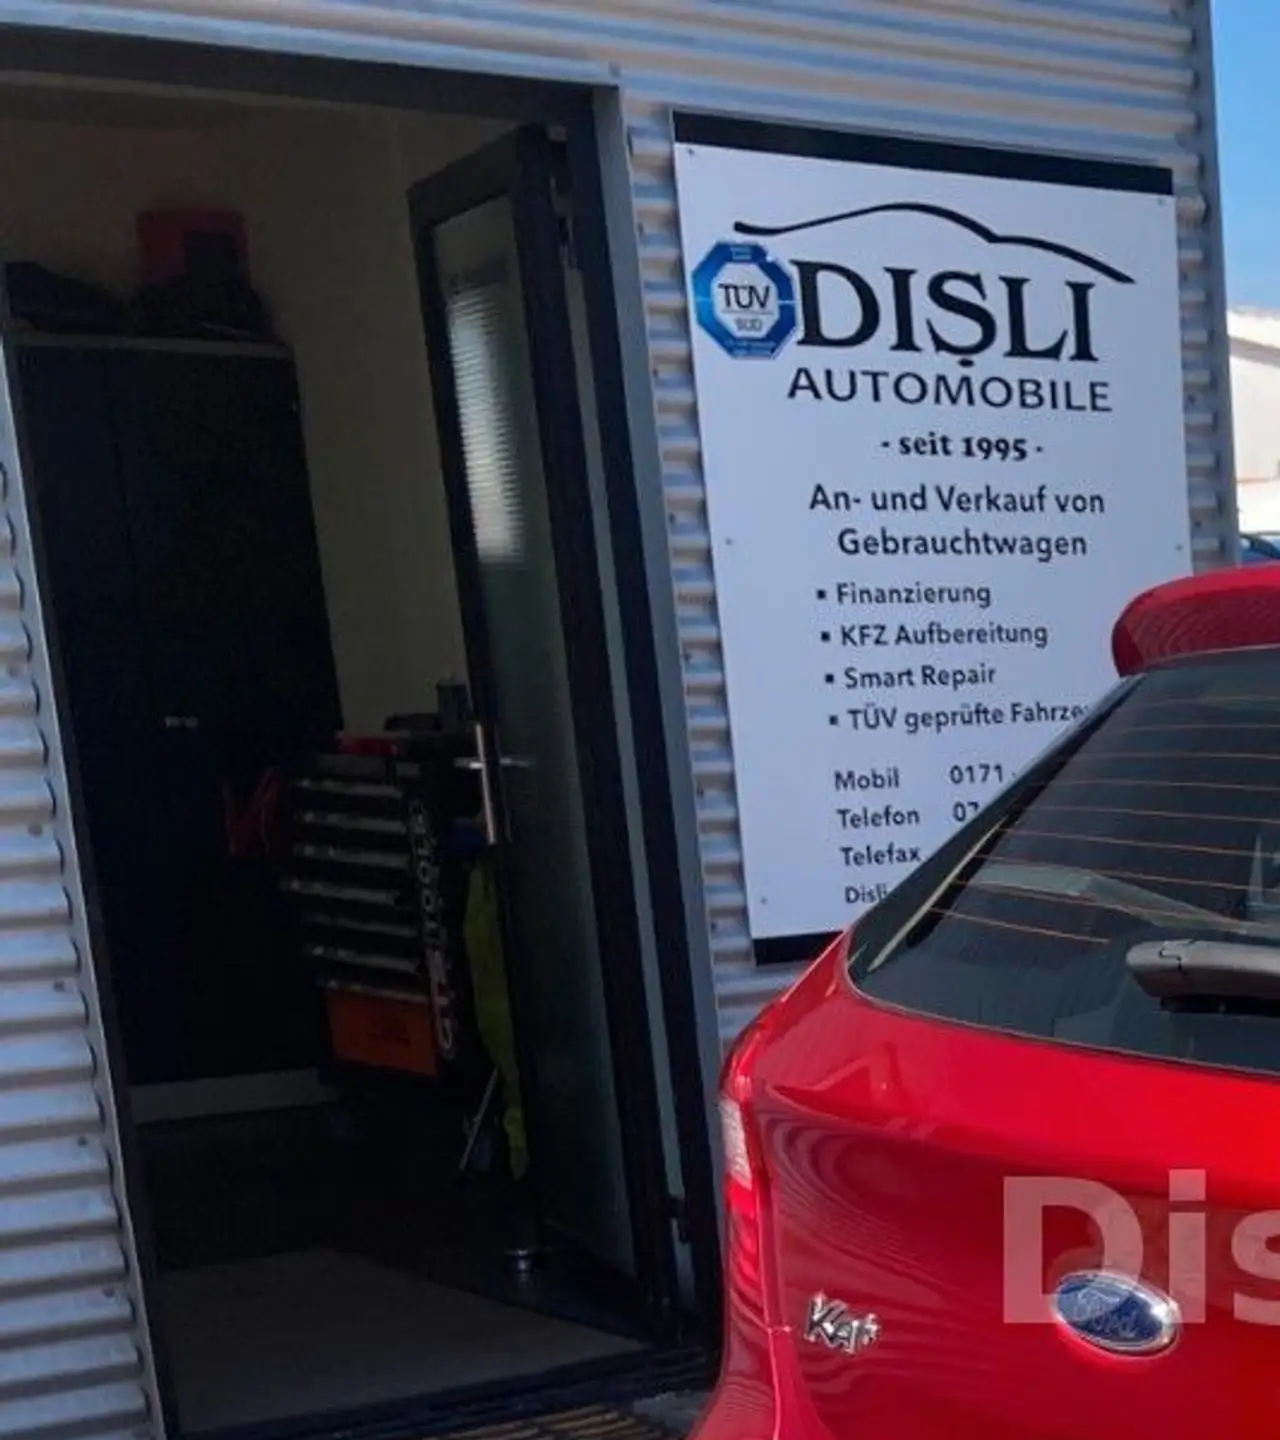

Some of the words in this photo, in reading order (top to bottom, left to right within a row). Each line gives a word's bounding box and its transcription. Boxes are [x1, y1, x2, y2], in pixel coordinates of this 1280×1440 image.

[717, 281, 771, 309] TÜV
[787, 366, 1112, 412] AUTOMOBILE
[899, 431, 952, 457] seit
[962, 436, 1028, 462] 1995
[808, 483, 862, 512] An-
[871, 484, 926, 513] und
[935, 484, 1047, 513] Verkauf
[1054, 494, 1105, 514] von
[837, 527, 1087, 561] Gebrauchtwagen
[836, 582, 991, 609] Finanzierung
[841, 624, 888, 647] KFZ
[894, 621, 1048, 649] Aufbereitung
[844, 666, 915, 690] Smart
[921, 662, 996, 691] Repair
[847, 702, 897, 730] TÜV
[904, 702, 1004, 734] geprüfte
[834, 767, 899, 791] Mobil
[950, 763, 1003, 785] 0171
[837, 804, 920, 829] Telefon
[840, 842, 921, 867] Telefax
